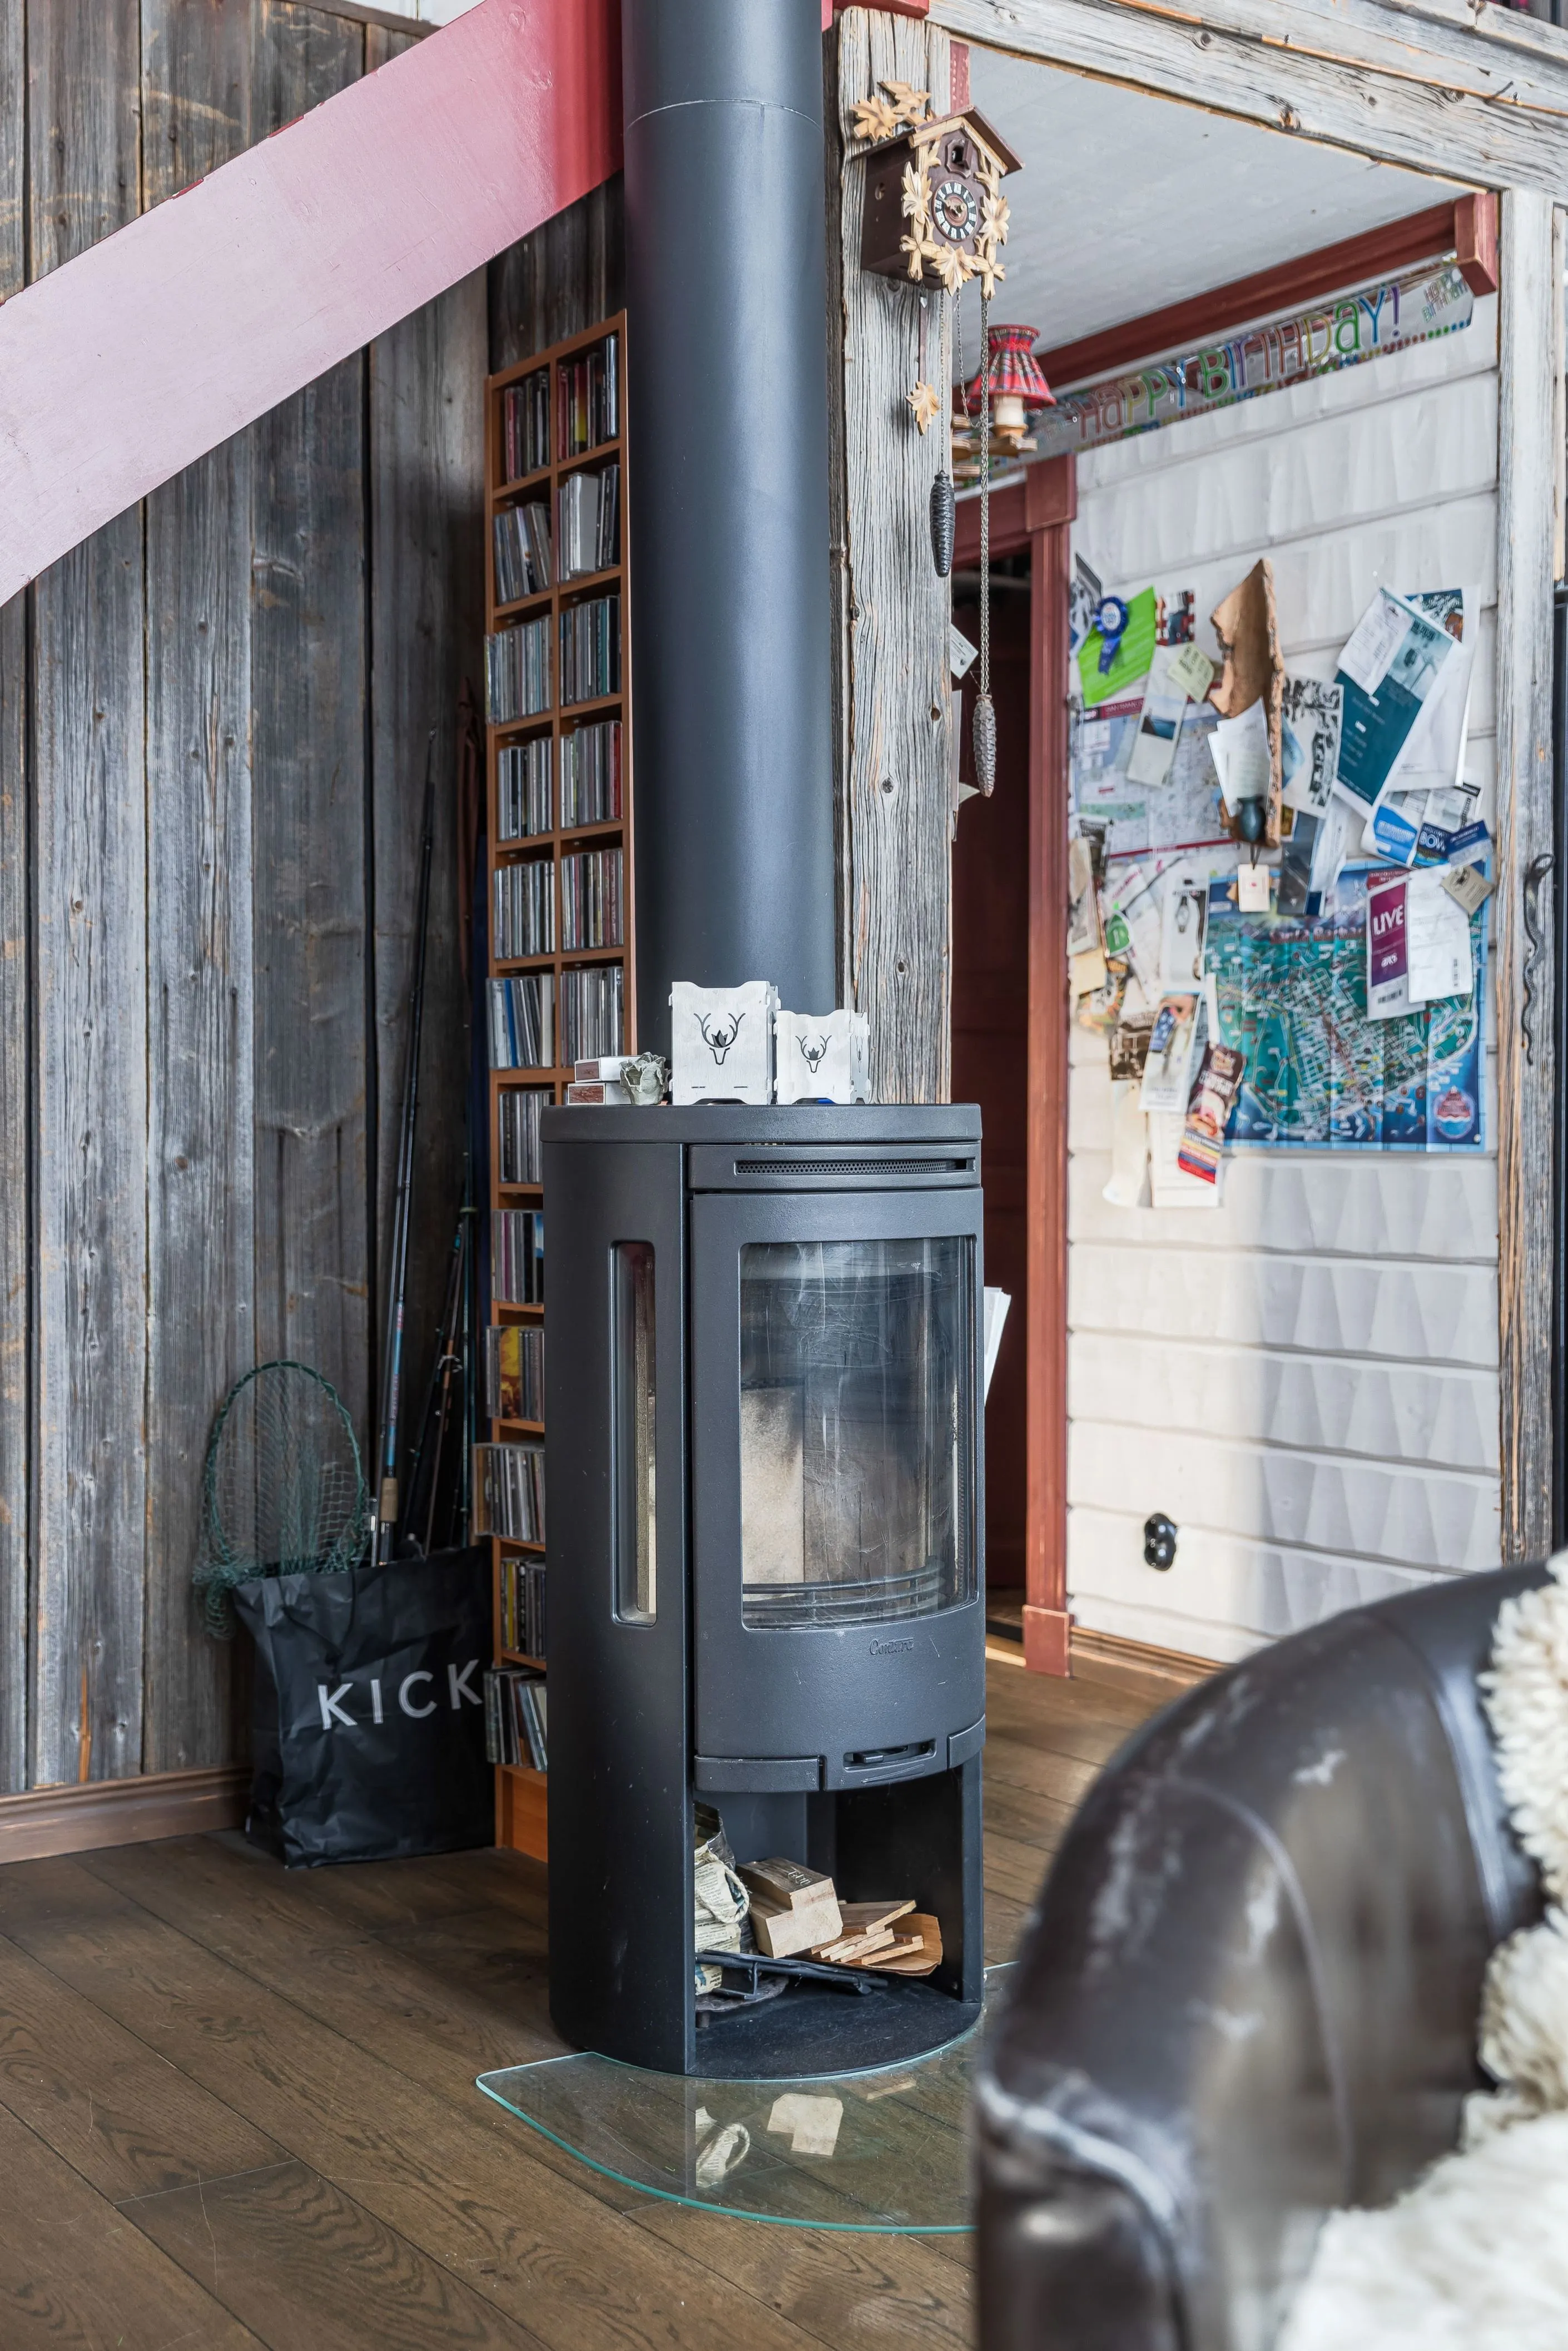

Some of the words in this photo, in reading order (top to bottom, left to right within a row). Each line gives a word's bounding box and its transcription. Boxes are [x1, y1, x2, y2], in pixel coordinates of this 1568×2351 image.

[1373, 904, 1403, 935] LIVE
[869, 1637, 914, 1655] Contura
[317, 1659, 483, 1730] KICK
